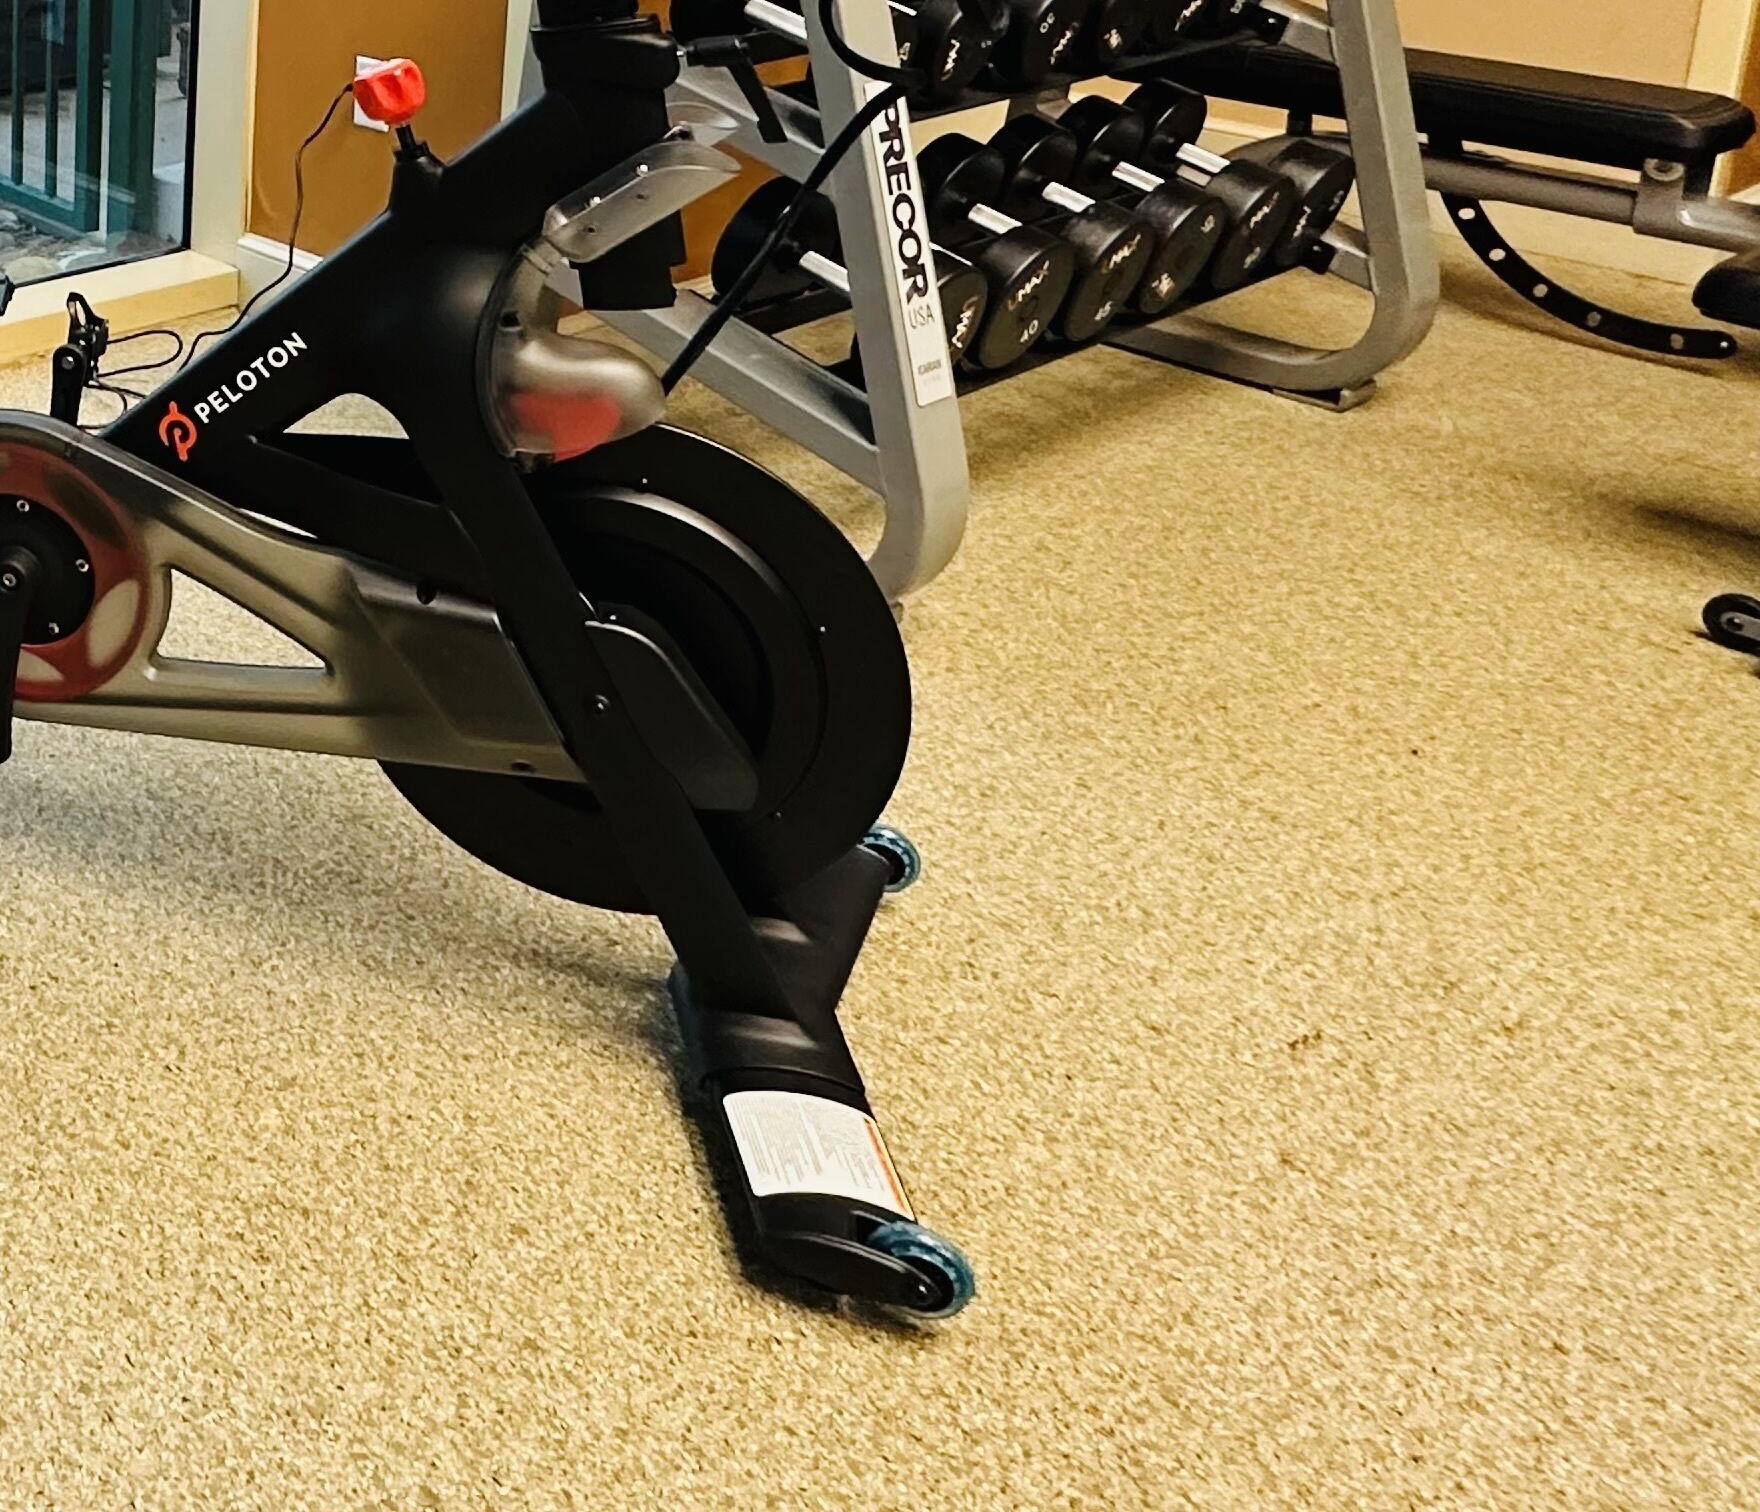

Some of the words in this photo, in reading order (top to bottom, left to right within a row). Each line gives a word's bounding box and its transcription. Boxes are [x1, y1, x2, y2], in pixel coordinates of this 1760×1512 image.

[908, 303, 936, 329] USA
[1019, 319, 1039, 344] 40
[194, 332, 308, 424] PELOTON
